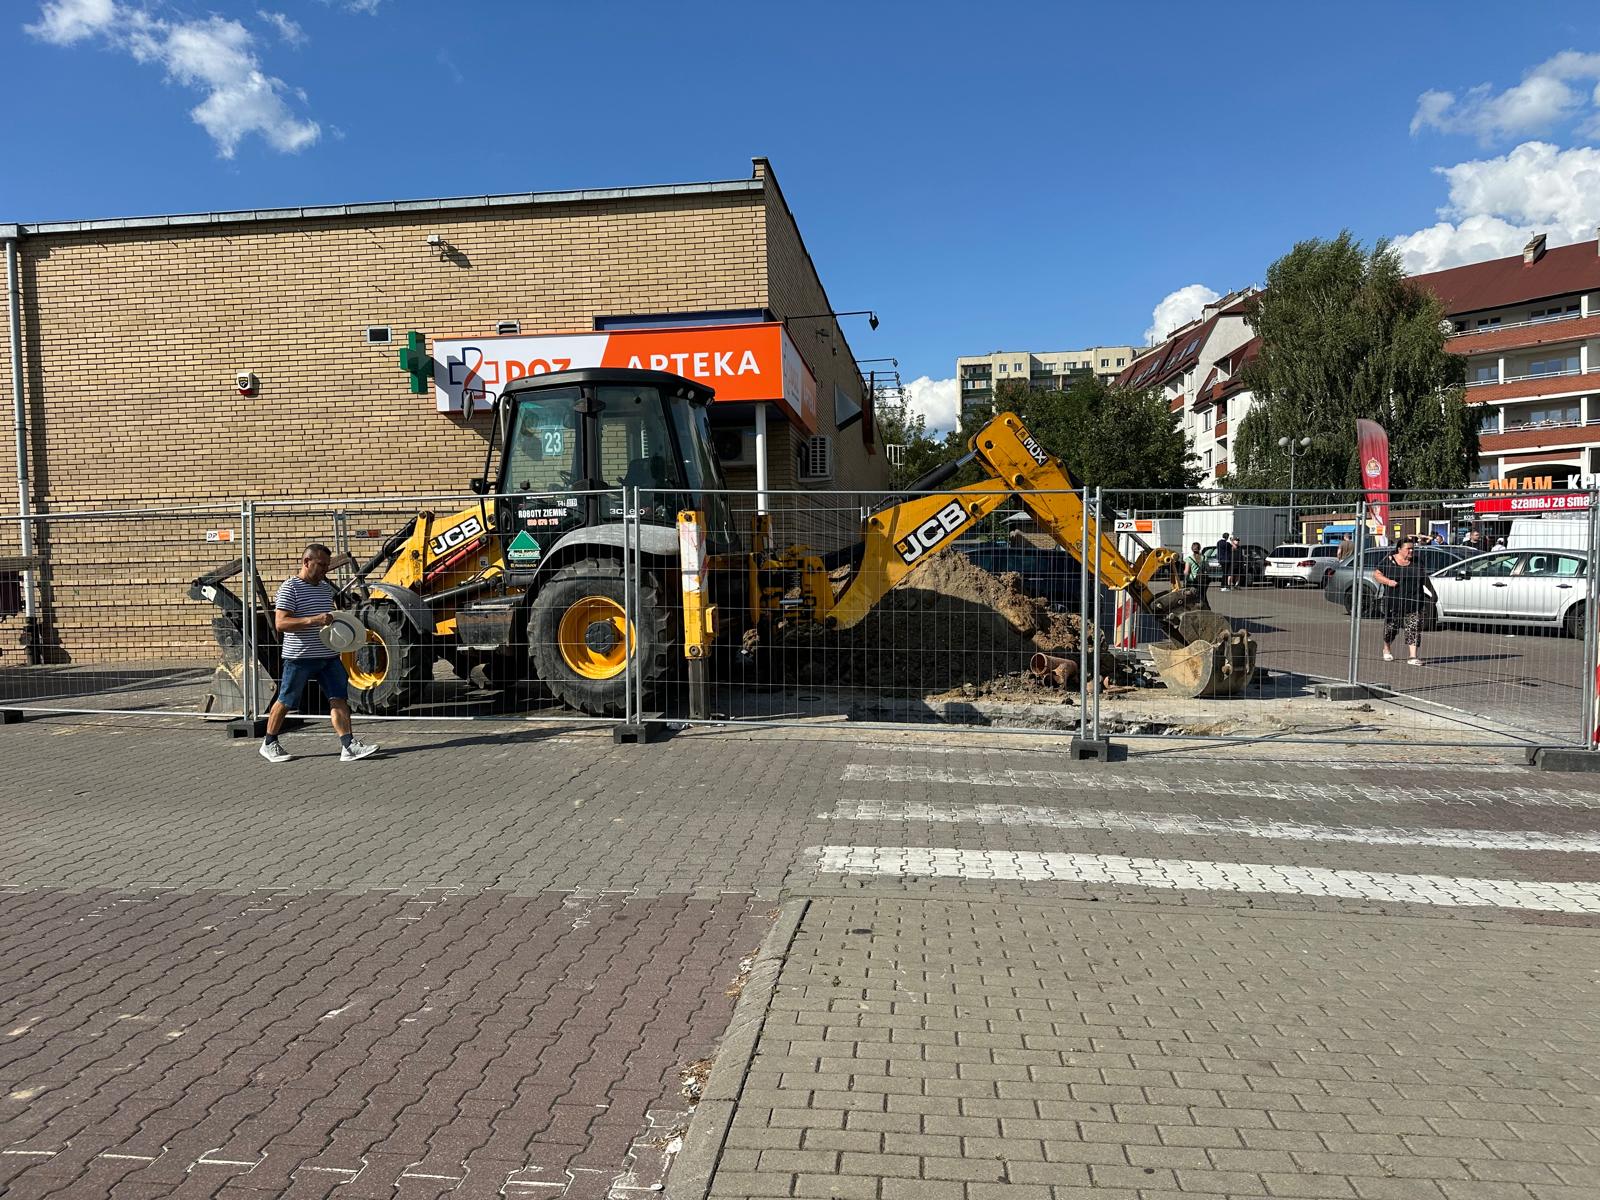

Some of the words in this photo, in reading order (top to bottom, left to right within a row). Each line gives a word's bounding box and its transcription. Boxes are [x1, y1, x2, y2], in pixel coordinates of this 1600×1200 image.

[544, 431, 562, 453] 23
[1023, 435, 1049, 467] 3CX
[518, 509, 542, 519] ROBOTY
[542, 507, 568, 517] ZIEMNE
[1566, 495, 1591, 507] sma
[433, 517, 481, 555] JCB
[903, 502, 967, 562] JCB
